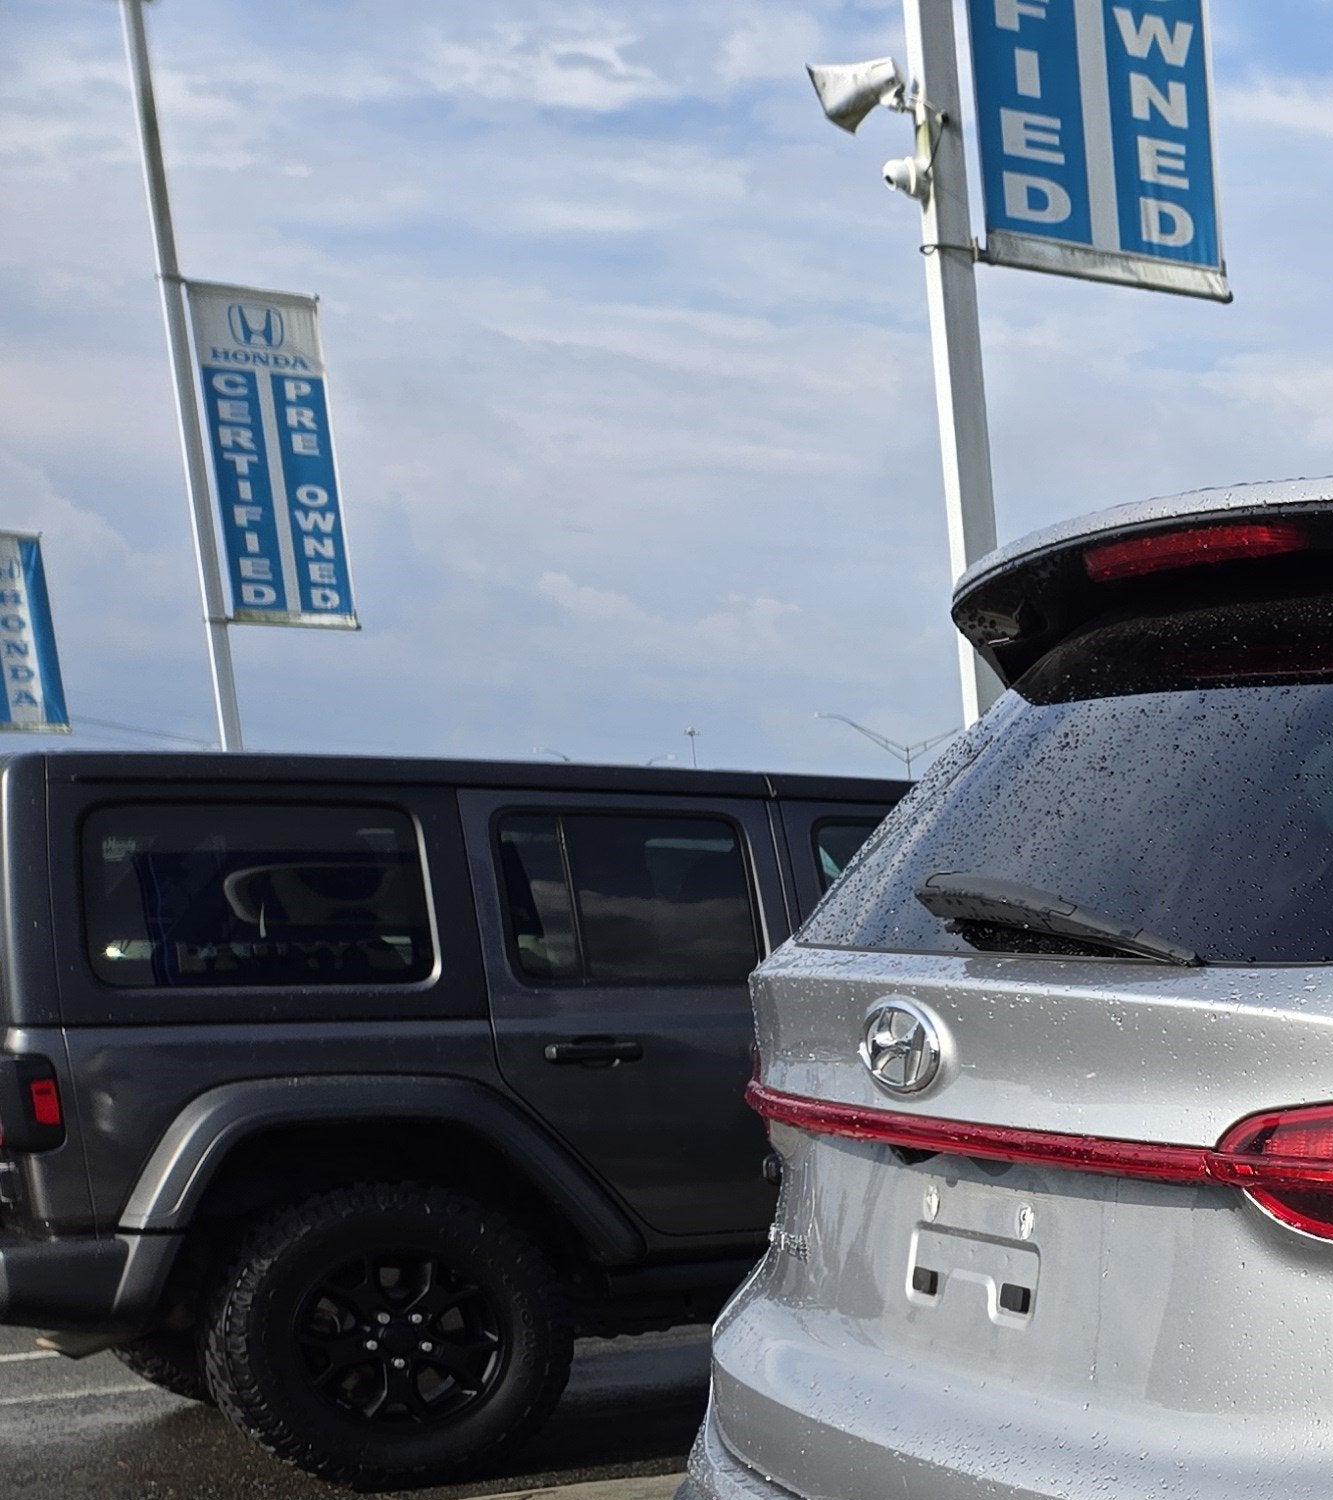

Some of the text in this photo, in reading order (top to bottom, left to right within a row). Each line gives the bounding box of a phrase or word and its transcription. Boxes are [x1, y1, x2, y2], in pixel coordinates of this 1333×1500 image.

[1112, 0, 1195, 247] WNED
[209, 346, 309, 371] HONDA
[211, 371, 277, 606] CERTIFIED
[283, 378, 341, 610] PRE OWNED
